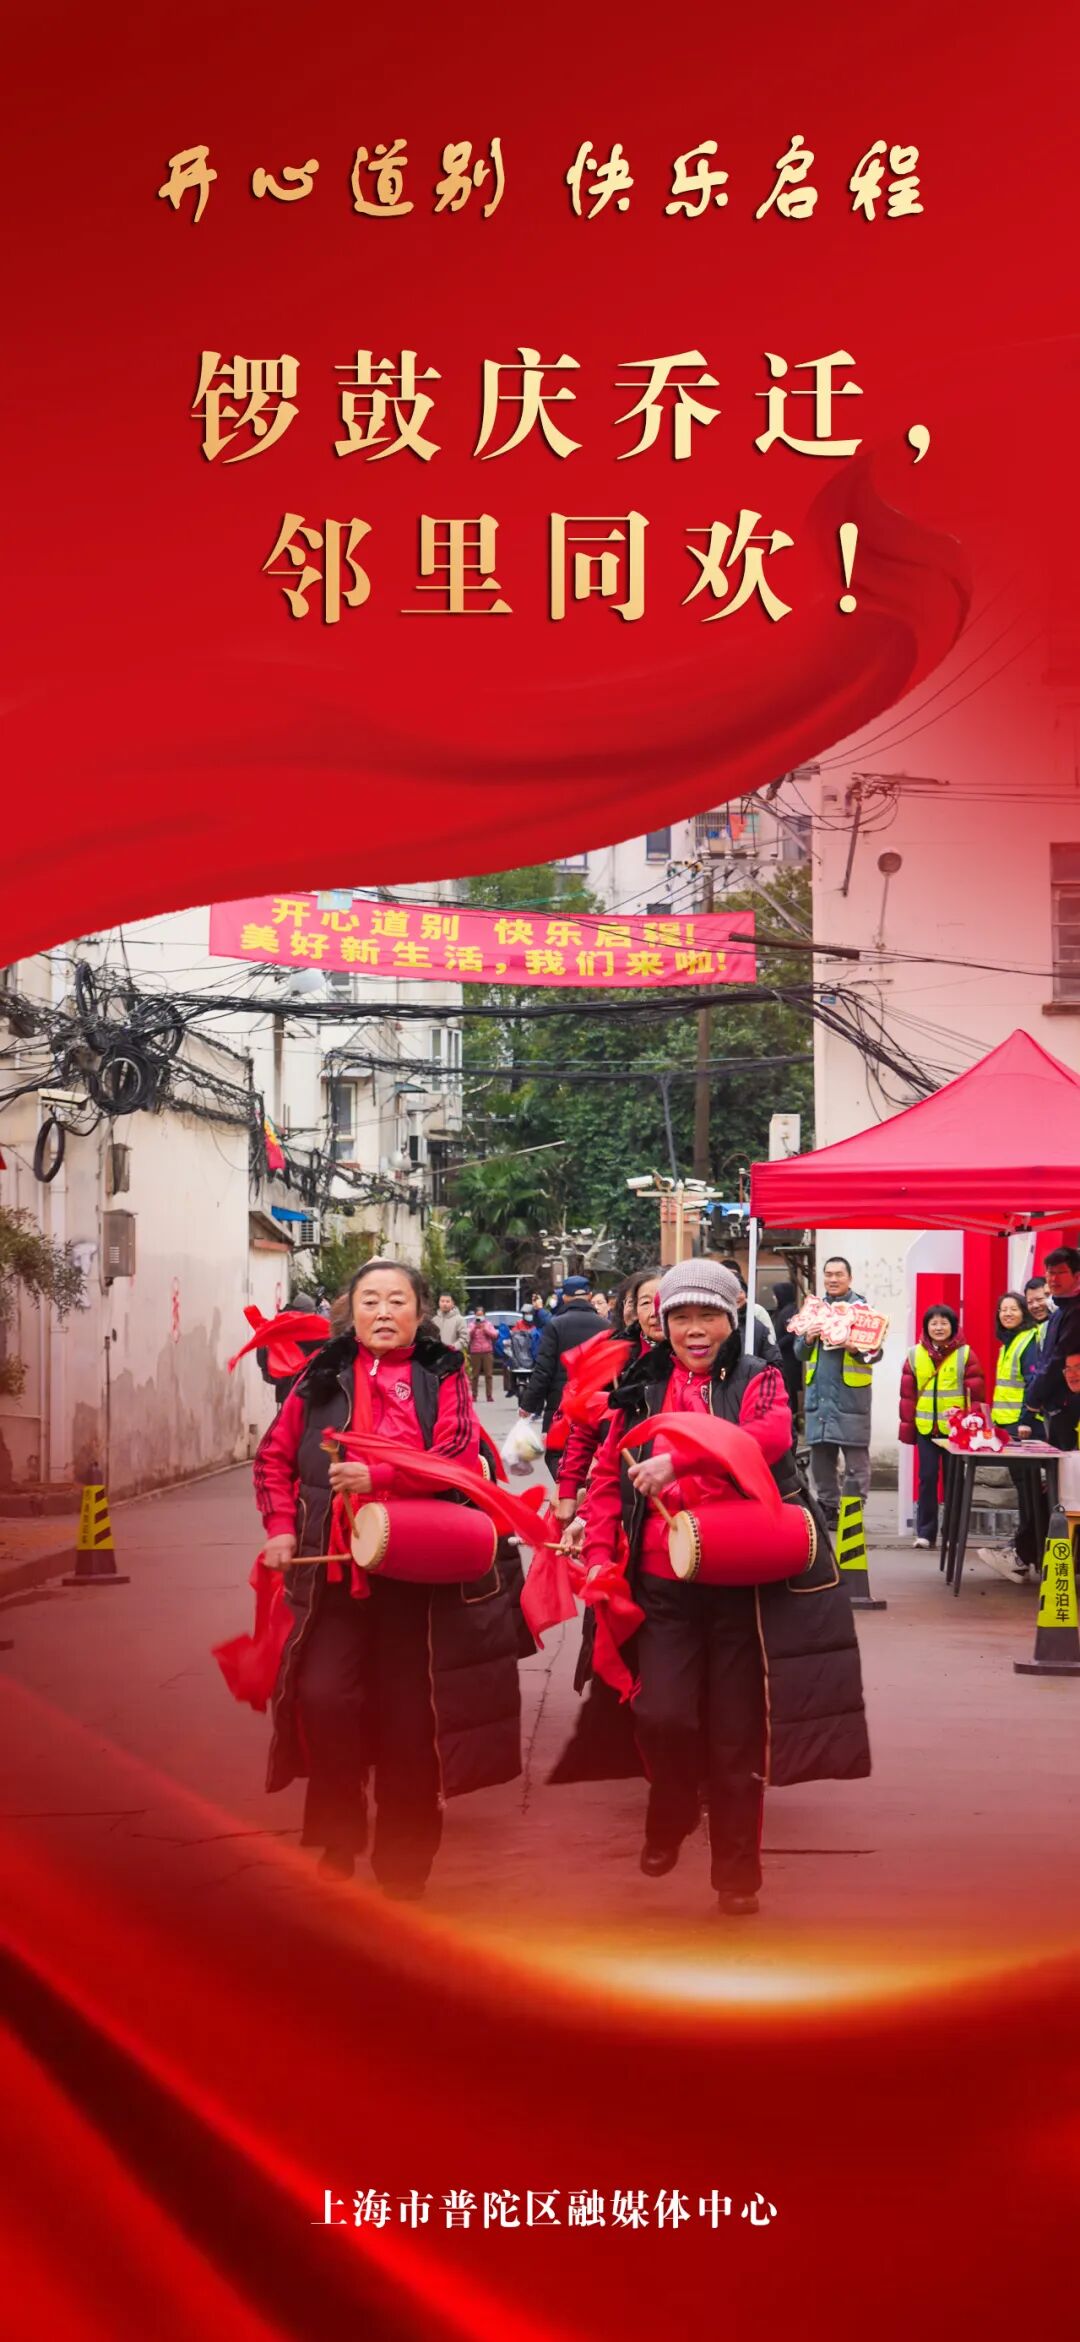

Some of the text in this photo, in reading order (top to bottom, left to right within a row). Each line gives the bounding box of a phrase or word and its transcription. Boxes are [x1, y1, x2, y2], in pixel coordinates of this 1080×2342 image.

[271, 897, 460, 941] 开心道别
[1054, 1562, 1071, 1622] 请勿泊车
